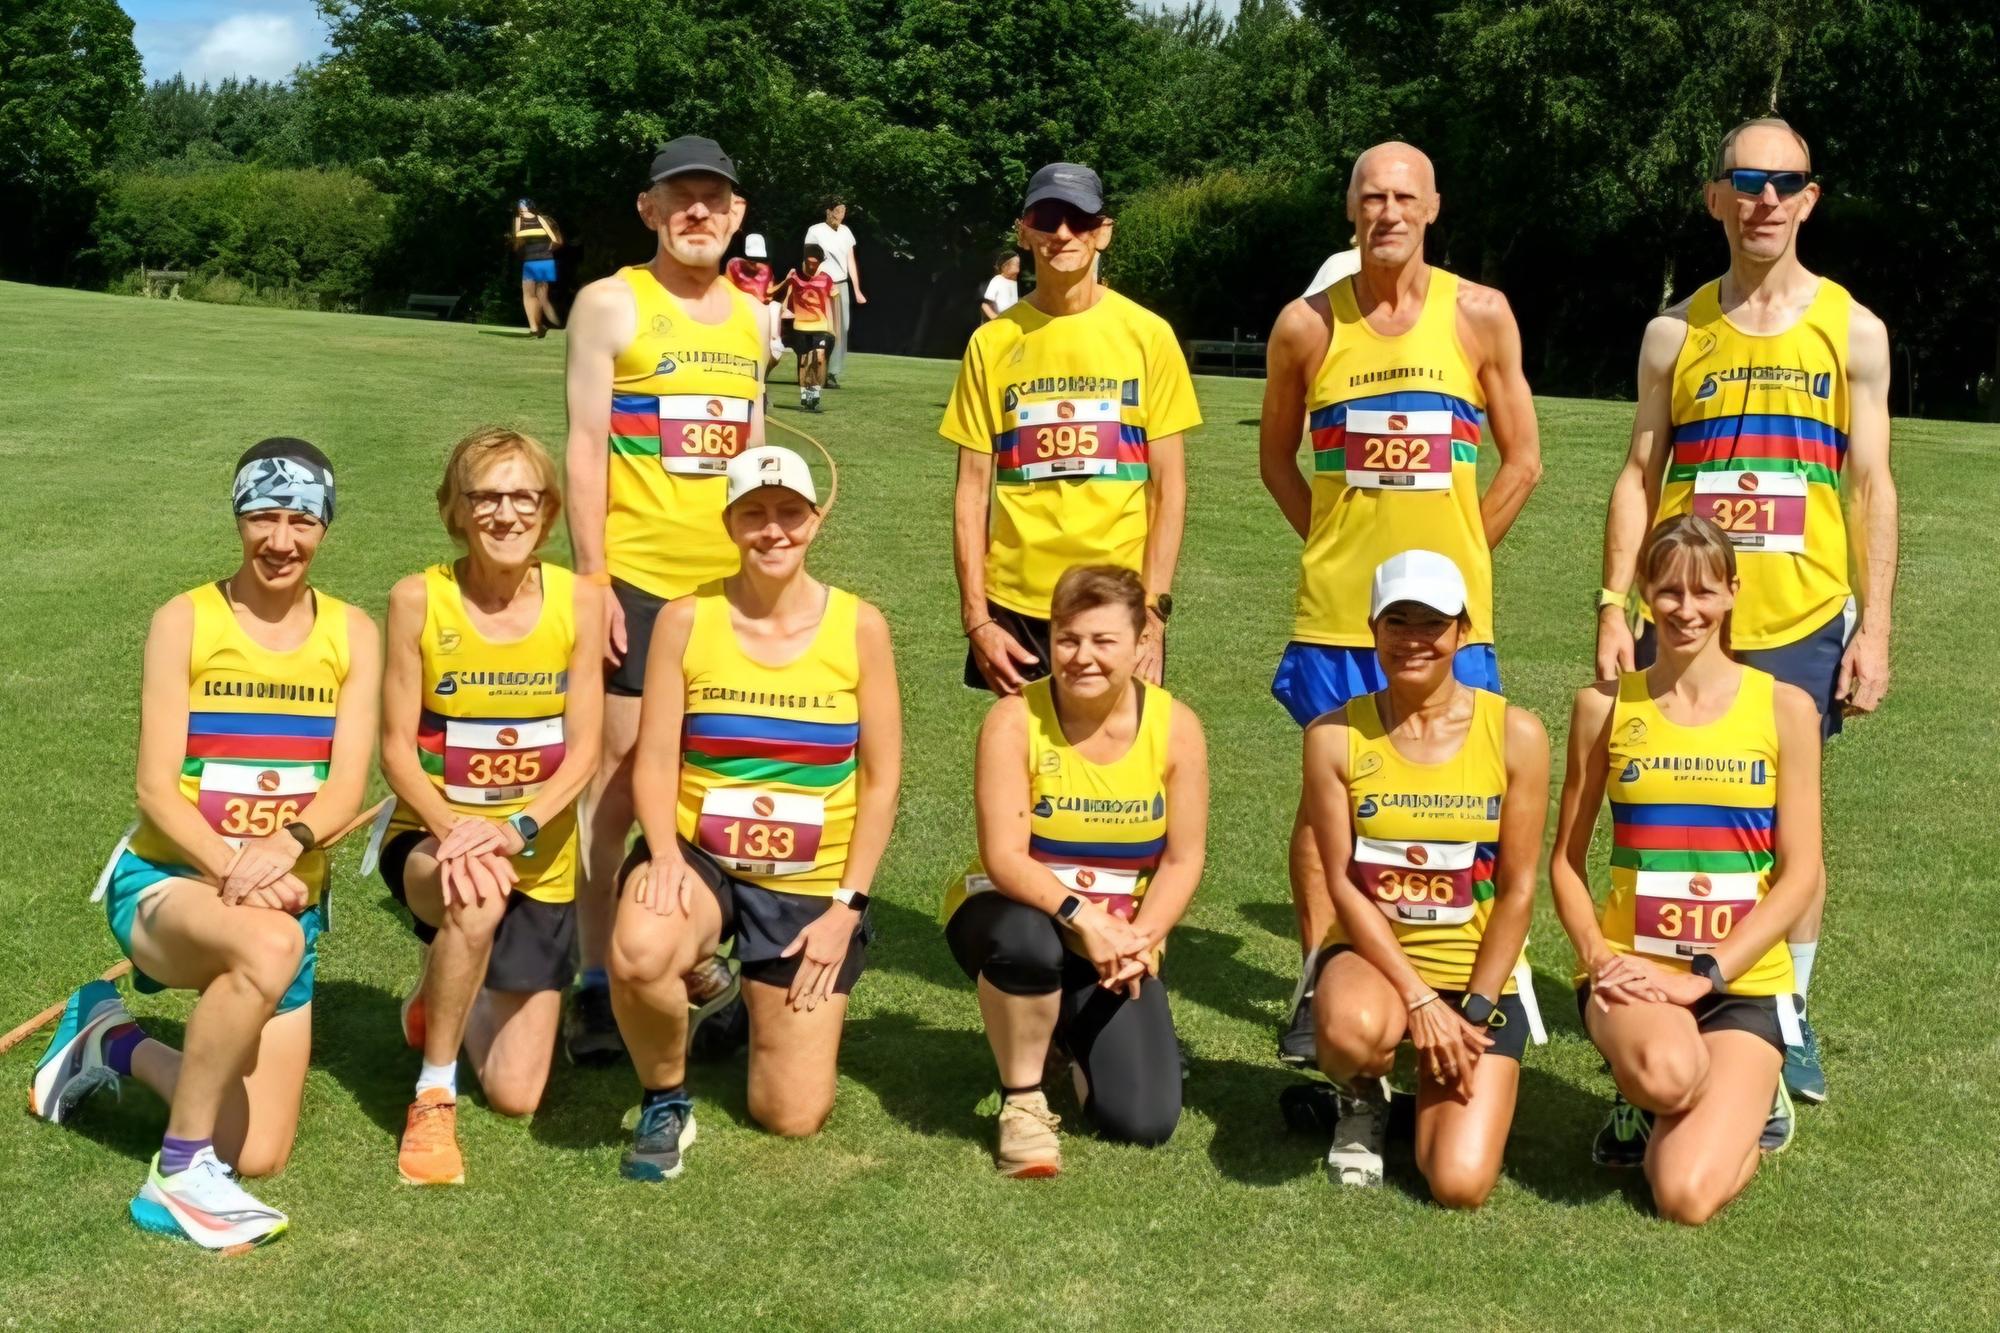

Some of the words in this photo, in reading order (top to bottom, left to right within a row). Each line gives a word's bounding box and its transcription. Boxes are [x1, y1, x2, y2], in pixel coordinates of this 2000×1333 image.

[681, 424, 737, 455] 363
[1036, 425, 1099, 458] 395
[1363, 438, 1431, 469] 262
[1710, 499, 1775, 531] 321
[466, 751, 541, 785] 335
[220, 798, 299, 836] 356
[723, 820, 795, 859] 133
[1376, 870, 1454, 905] 366
[1657, 903, 1732, 940] 310
